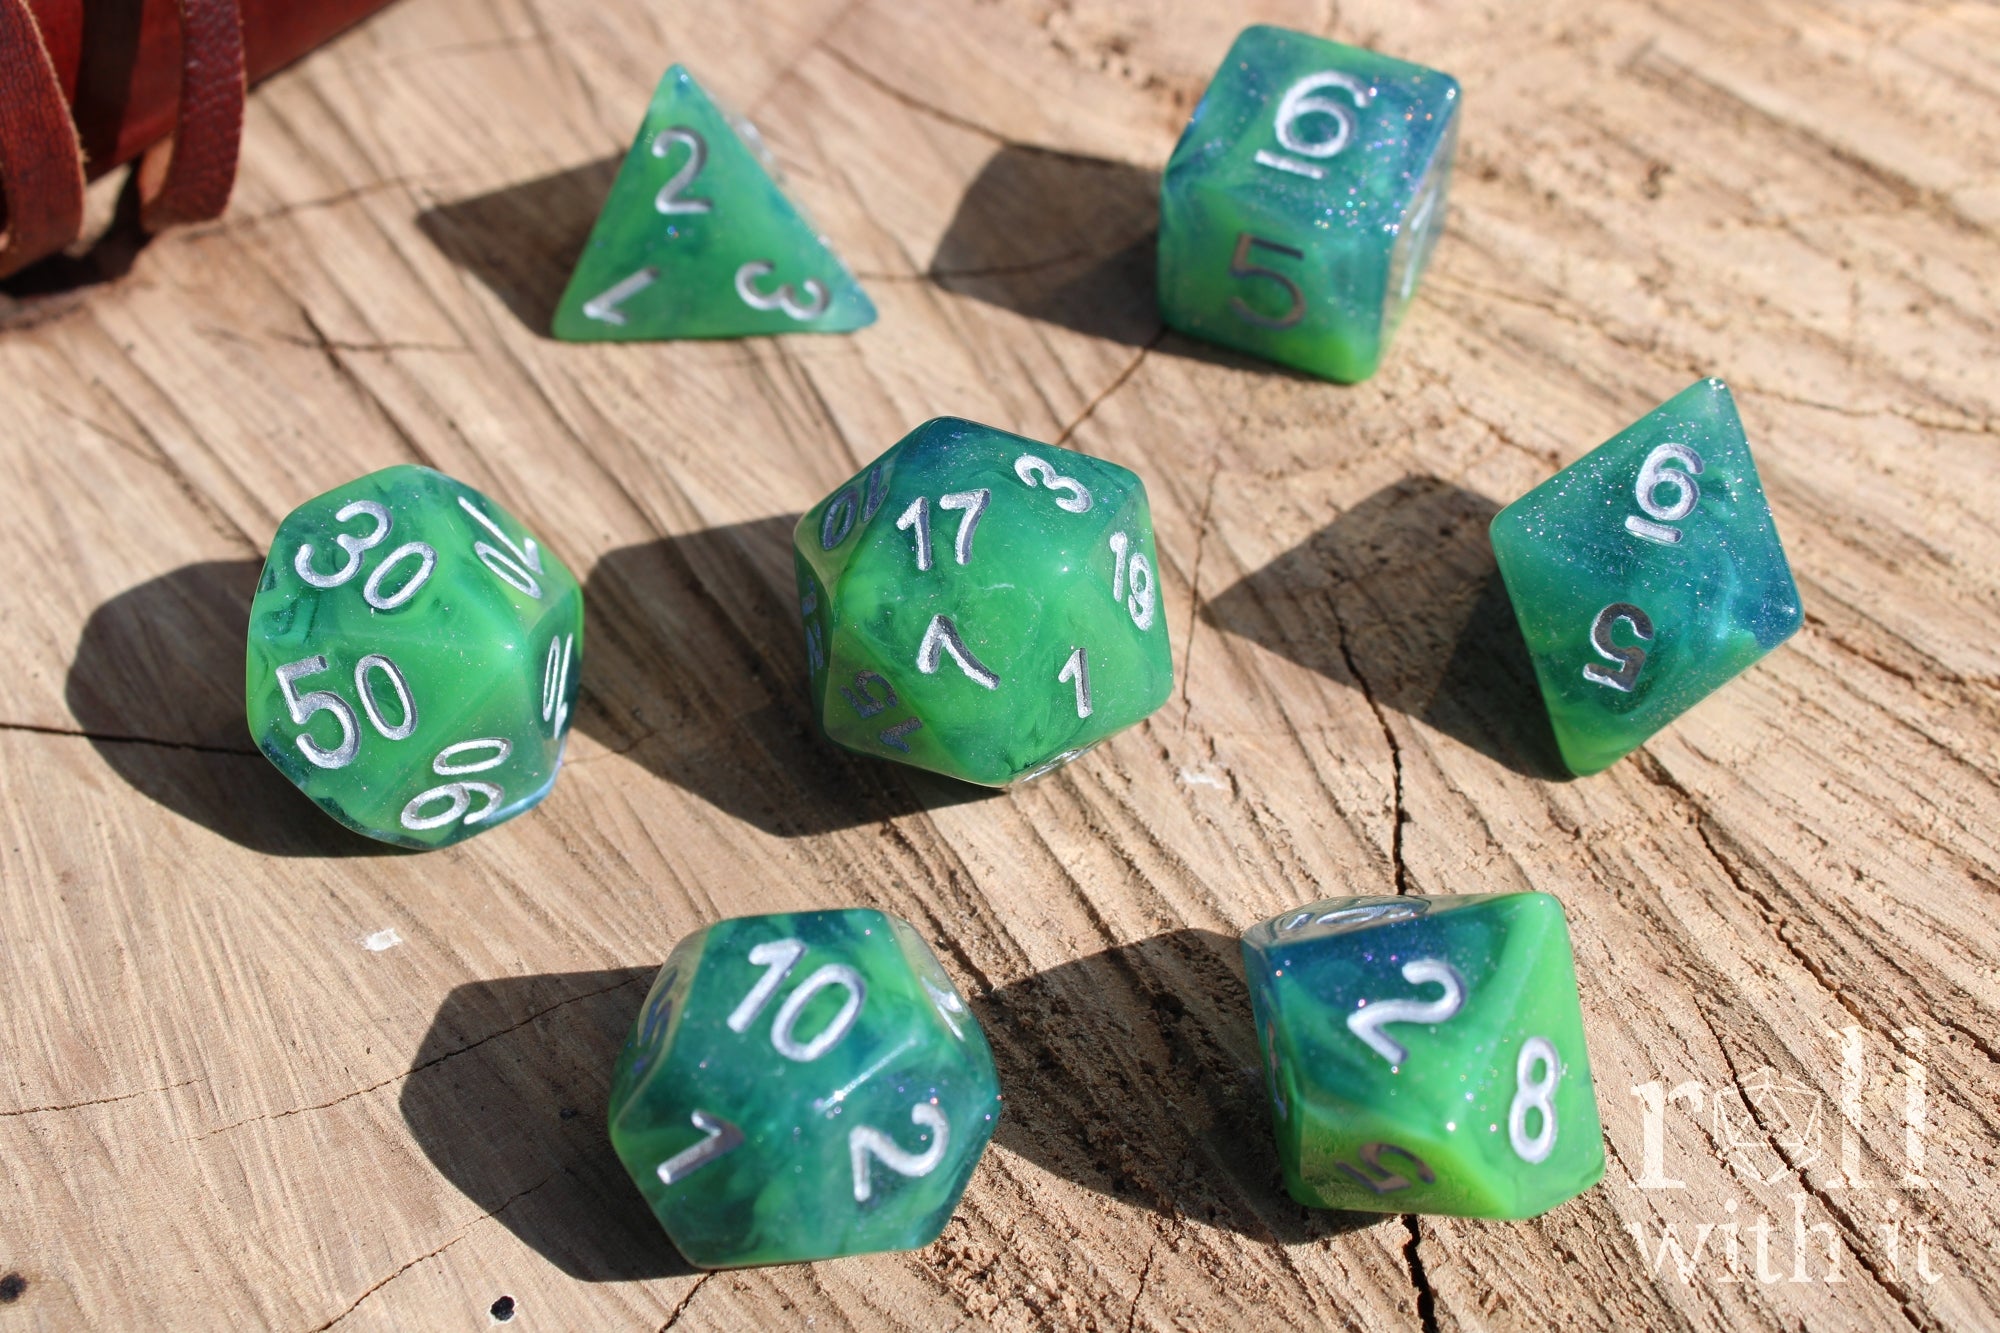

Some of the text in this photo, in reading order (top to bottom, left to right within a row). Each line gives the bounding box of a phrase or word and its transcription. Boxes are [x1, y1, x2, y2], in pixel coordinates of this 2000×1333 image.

[652, 125, 713, 214] 2
[583, 266, 660, 326] 1
[735, 259, 832, 321] 3
[1230, 232, 1307, 331] 5
[896, 488, 991, 571] 17
[1014, 454, 1093, 513] 3
[294, 500, 438, 609] 30
[1109, 531, 1155, 631] 19
[1058, 647, 1092, 718] 1
[1582, 602, 1655, 692] 5
[275, 654, 417, 769] 50
[727, 938, 866, 1062] 10
[1347, 959, 1467, 1064] 2
[1508, 1036, 1560, 1164] 8
[850, 1103, 950, 1202] 2
[1335, 1142, 1435, 1194] 5
